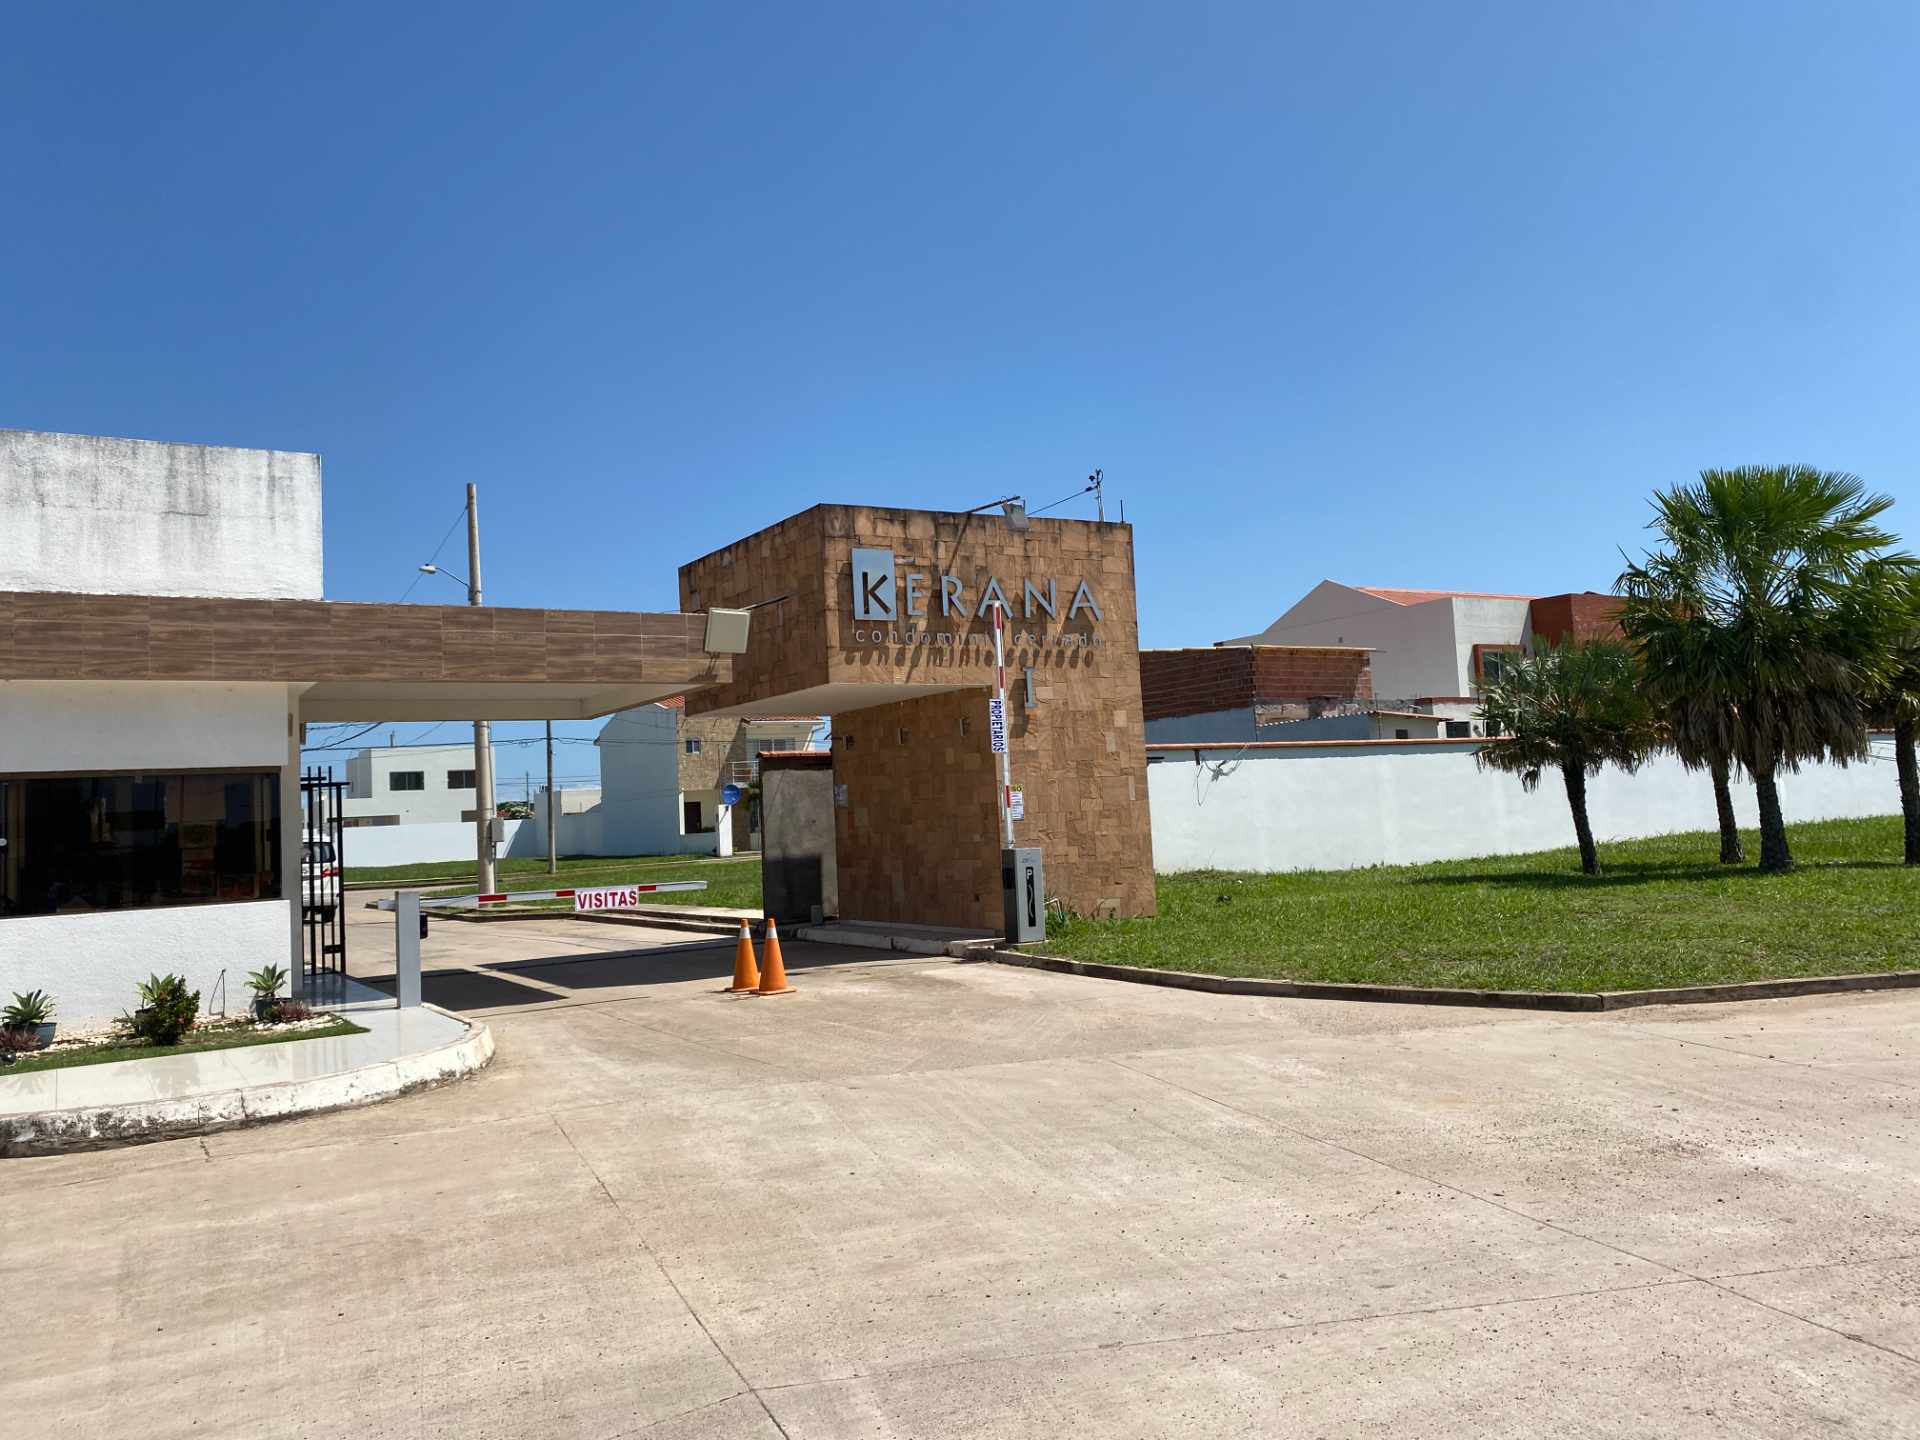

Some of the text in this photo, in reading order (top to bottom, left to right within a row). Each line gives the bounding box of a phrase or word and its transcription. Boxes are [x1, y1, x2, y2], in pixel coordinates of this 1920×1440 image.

[862, 571, 1105, 622] KERANA
[855, 628, 994, 646] condomini
[991, 700, 1005, 752] PROPIETARIOS
[577, 890, 637, 909] VISITAS
